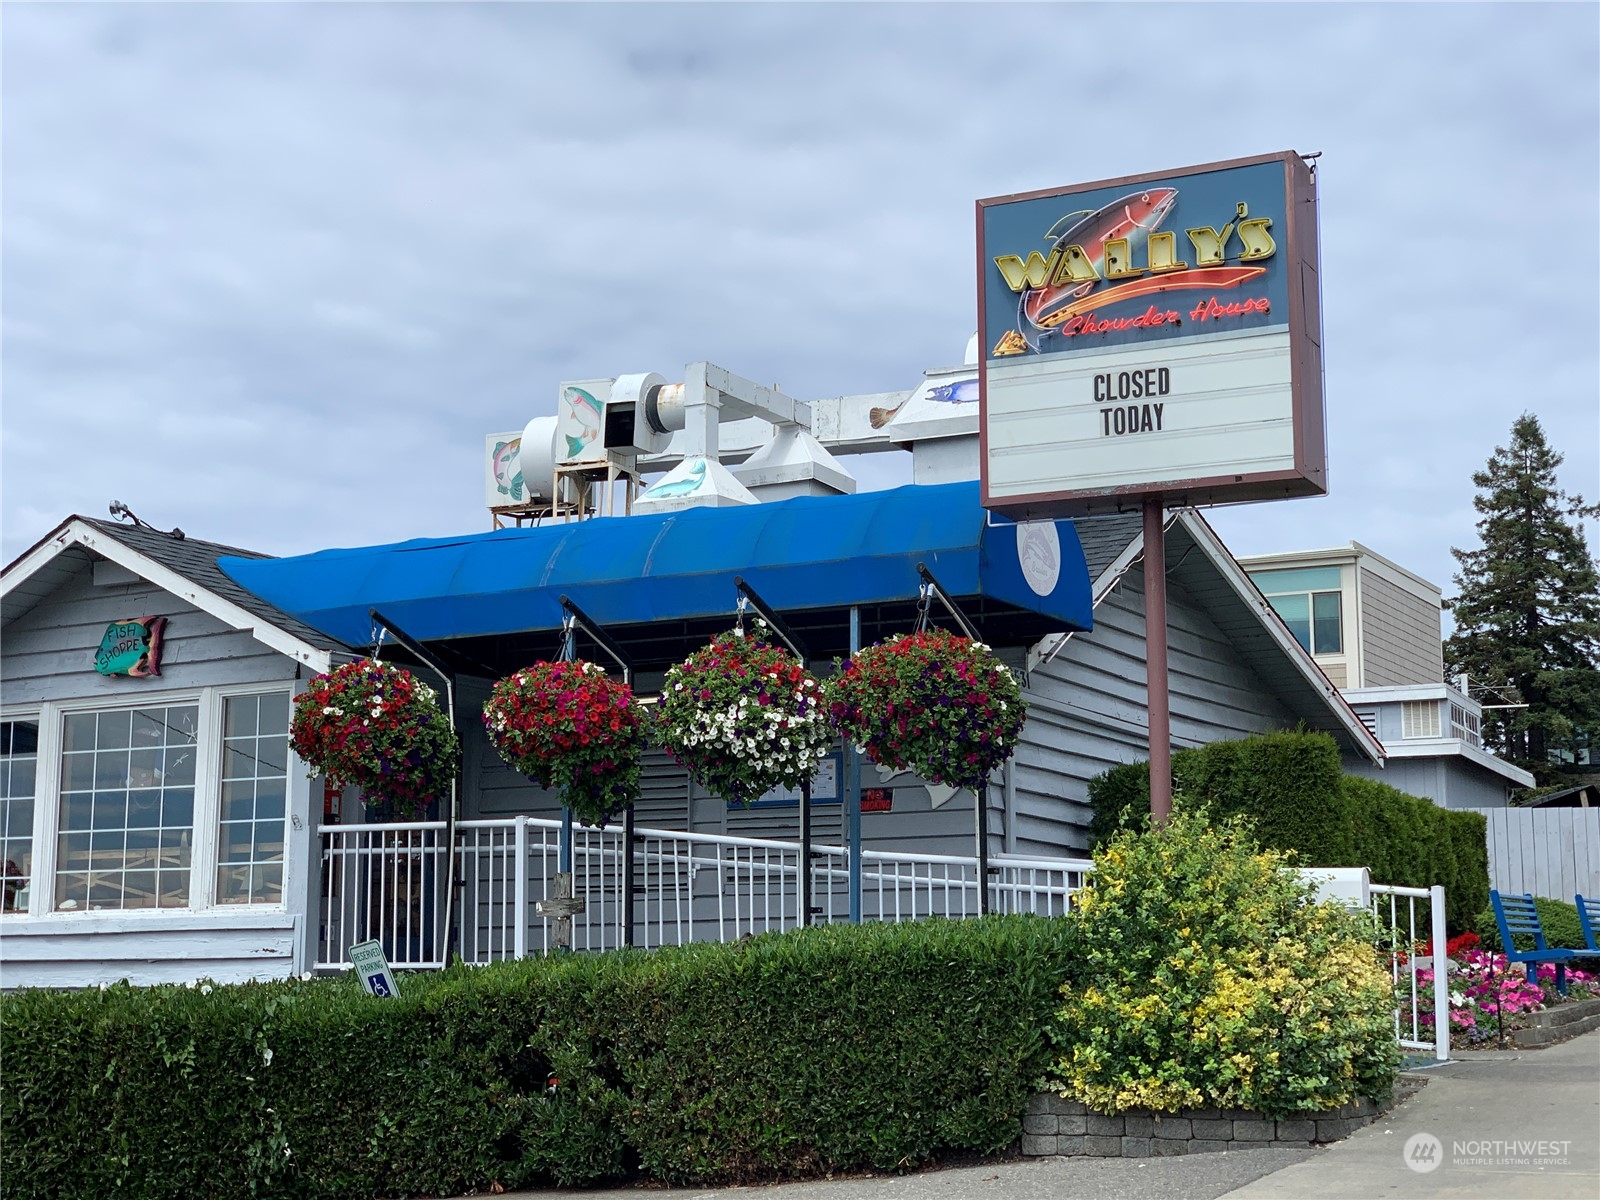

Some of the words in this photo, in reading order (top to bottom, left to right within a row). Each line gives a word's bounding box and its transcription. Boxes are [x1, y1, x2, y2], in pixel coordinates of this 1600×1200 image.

[993, 202, 1277, 292] WALLY'S
[1061, 305, 1180, 337] Chowder
[1190, 297, 1271, 322] House
[1093, 367, 1170, 402] CLOSED
[1100, 403, 1164, 436] TODAY
[107, 625, 136, 642] FISH
[100, 639, 139, 670] SHOPPE
[353, 947, 381, 962] RESERVED
[360, 960, 384, 974] PARKING
